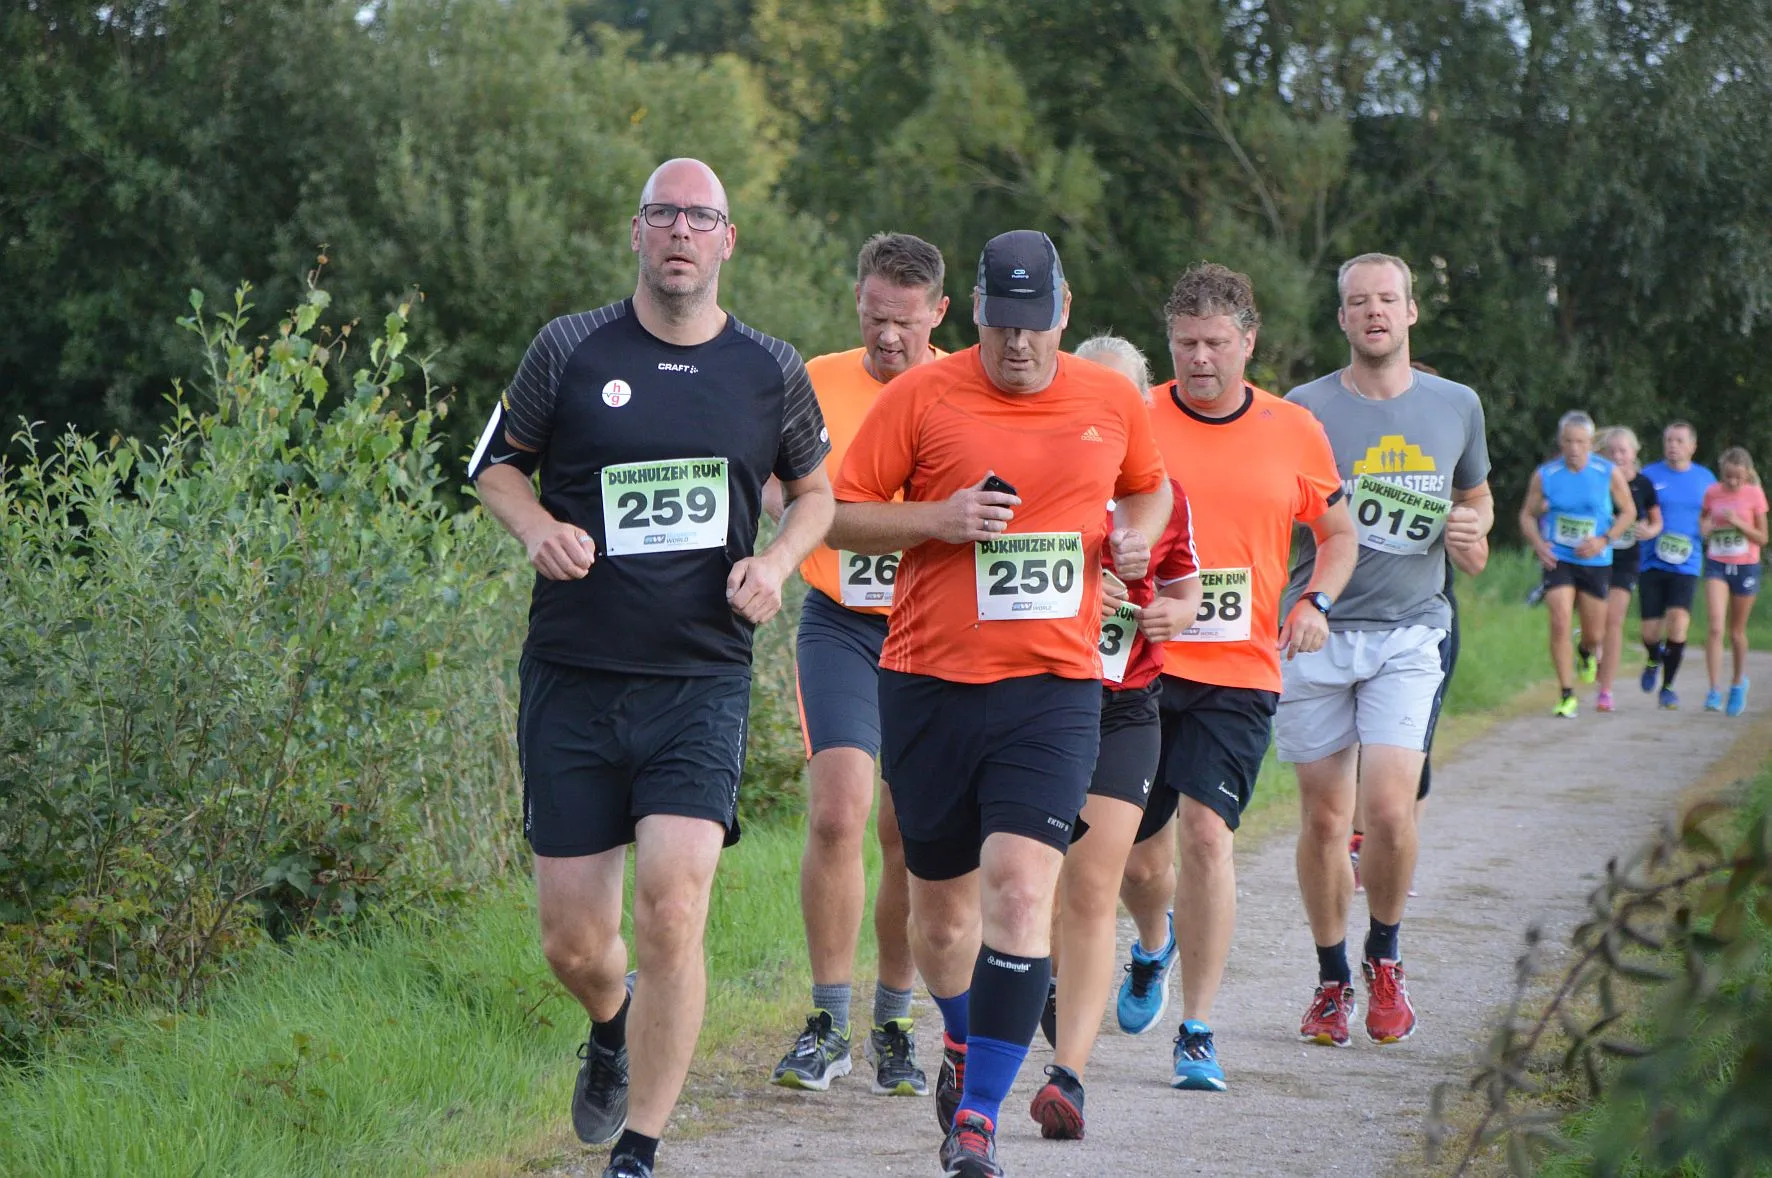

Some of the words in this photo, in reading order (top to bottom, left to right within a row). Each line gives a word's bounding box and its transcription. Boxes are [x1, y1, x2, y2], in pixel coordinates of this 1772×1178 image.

[658, 363, 689, 373] CRAFT
[613, 383, 621, 393] h
[611, 395, 620, 406] g
[692, 463, 721, 478] RUN
[617, 486, 717, 529] 259
[1422, 499, 1446, 515] RUN
[1358, 498, 1435, 541] 015
[1058, 538, 1079, 552] RUN
[848, 554, 899, 586] 26
[988, 558, 1074, 596] 250
[1226, 573, 1246, 586] RUN
[1195, 591, 1242, 622] 58
